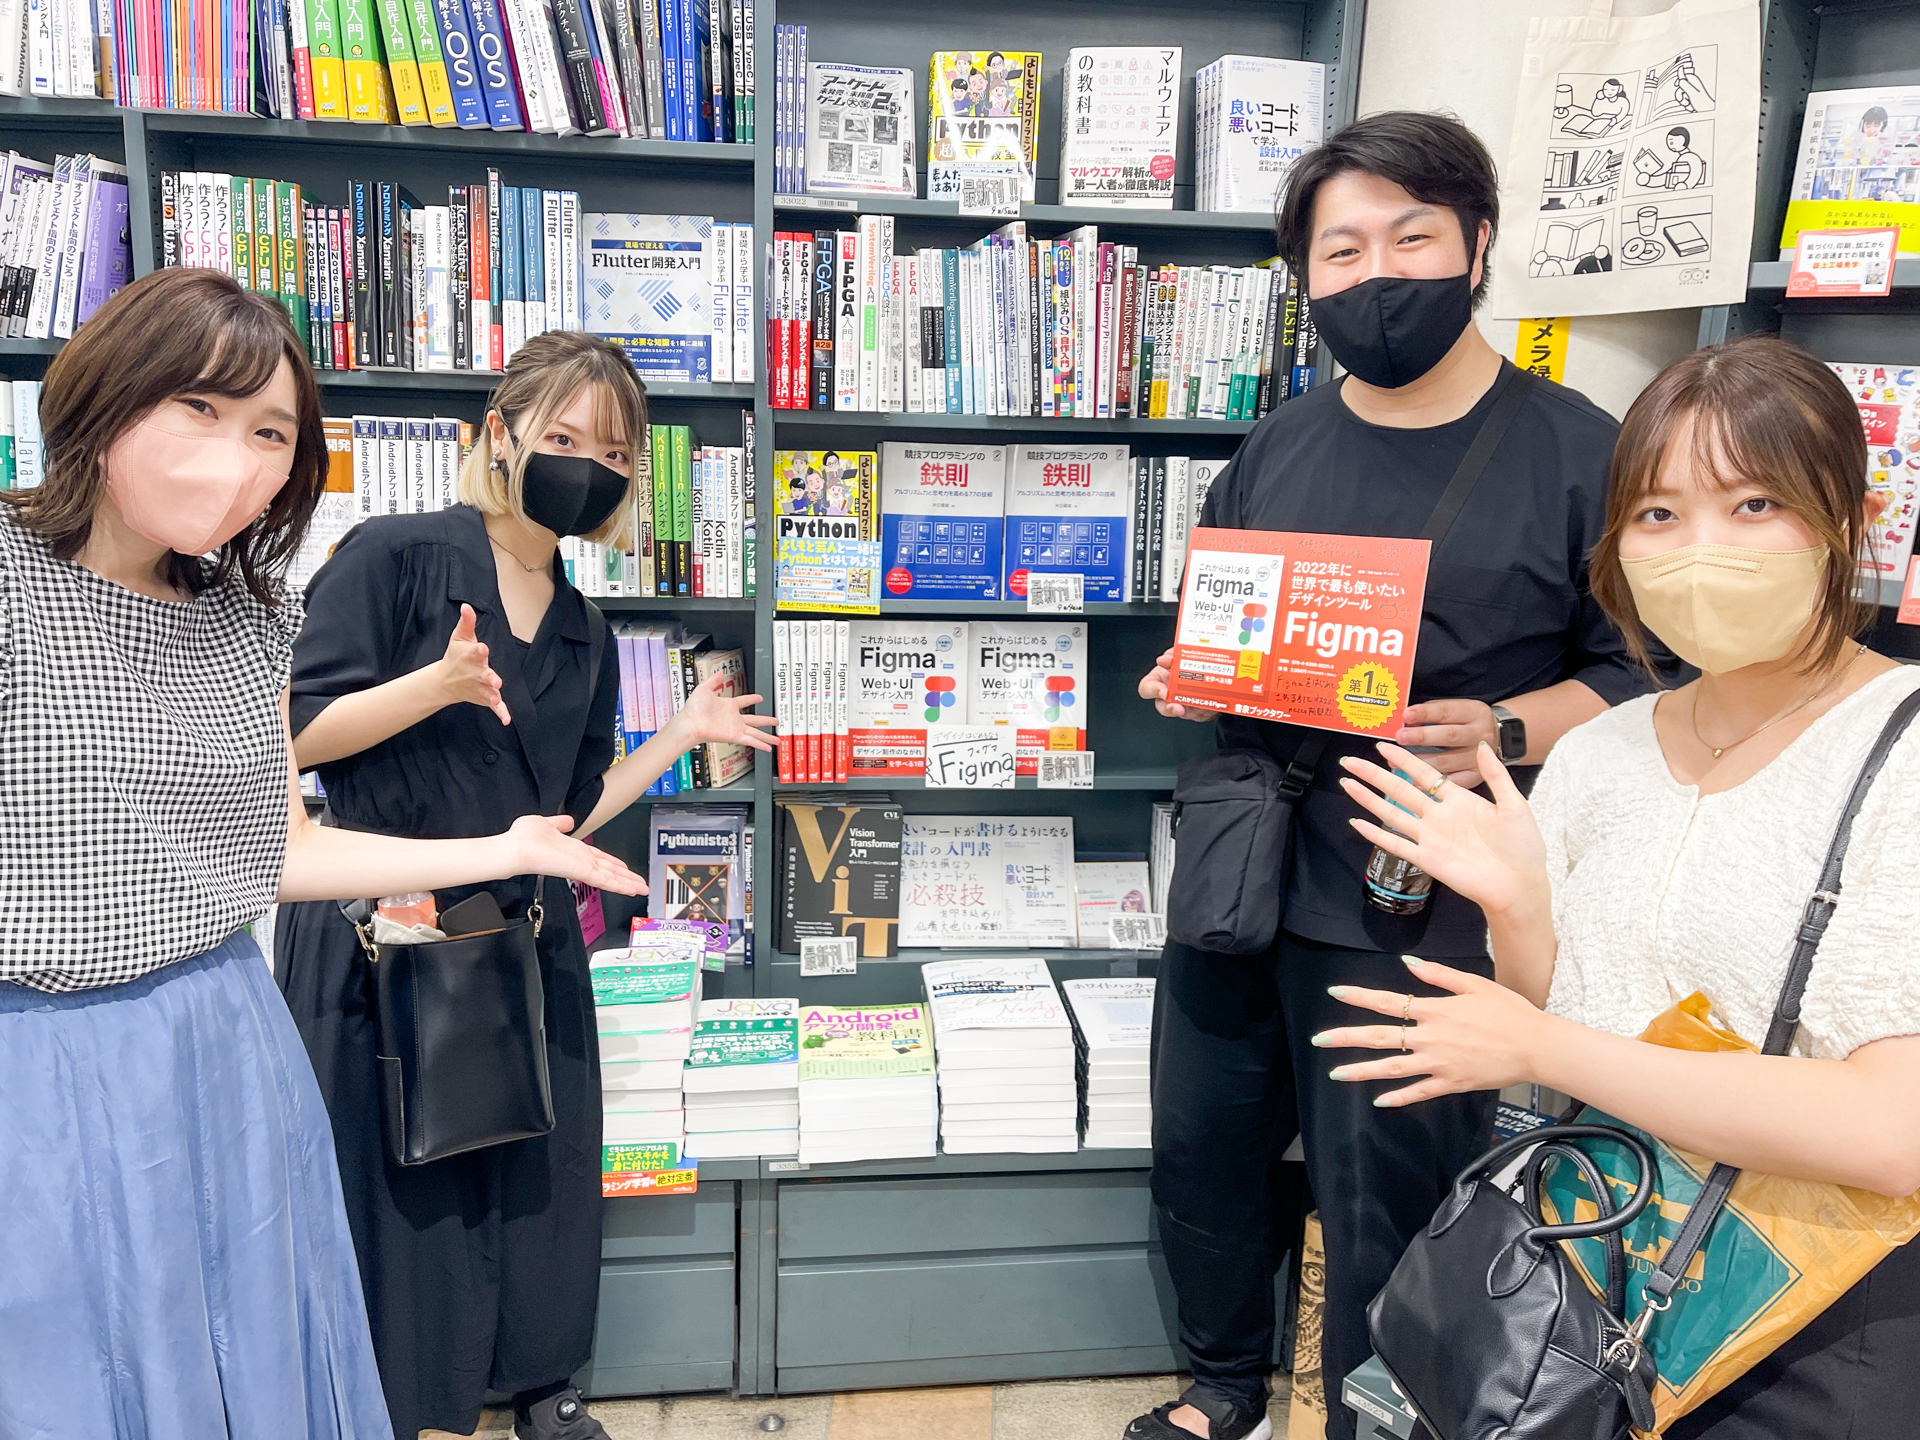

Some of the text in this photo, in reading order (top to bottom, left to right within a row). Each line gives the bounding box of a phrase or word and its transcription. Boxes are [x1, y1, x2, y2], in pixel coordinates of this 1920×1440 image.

[1075, 55, 1093, 134] の教科書
[1156, 51, 1174, 137] マルウエア
[1230, 99, 1299, 119] 良いコード
[1229, 116, 1299, 136] 悪いコード
[1251, 136, 1279, 146] で学ぶ
[1259, 146, 1301, 159] 設計入門
[1069, 166, 1152, 178] マルウエア解析の
[1074, 179, 1171, 191] 第一人者が徹底解説
[547, 199, 558, 238] Flutter
[563, 200, 574, 239] Flutter
[356, 236, 368, 279] Xamarin
[382, 236, 394, 280] Xamarin
[592, 253, 700, 270] Flutter開発入門
[816, 238, 832, 294] FPGA
[713, 285, 729, 333] Flutter
[736, 285, 751, 334] Flutter
[841, 261, 855, 341] FPGA入門
[1102, 286, 1111, 330] Raspberry
[1282, 298, 1298, 346] TLS 1.3
[19, 437, 37, 475] Java
[905, 450, 985, 461] 競技プログラミングの
[1027, 451, 1108, 461] 競技プログラミングの
[920, 462, 969, 487] 鉄則
[1042, 463, 1091, 487] 鉄則
[693, 488, 702, 523] Kotlin
[1136, 467, 1147, 551] ホワイトハッカーの学校
[1153, 468, 1164, 551] ホワイトハッカーの学校
[781, 518, 857, 538] Python
[703, 519, 714, 558] Kotlin
[716, 521, 726, 559] Kotlin
[781, 541, 880, 555] よしもと芸人と一緒に
[781, 553, 880, 568] Pythonをはじめよう!
[1199, 563, 1251, 575] これからはじめる
[1293, 561, 1353, 577] 2022年に
[1196, 573, 1255, 598] Figma
[1291, 576, 1405, 597] 世界で最も使いたい
[1289, 592, 1372, 611] デザインツール
[1193, 612, 1233, 623] デザイン入門
[860, 635, 928, 645] これからはじめる
[980, 636, 1047, 645] これからはじめる
[1283, 610, 1404, 658] Figma
[860, 647, 936, 673] Figma
[980, 647, 1055, 673] Figma
[778, 663, 787, 691] Figma
[794, 663, 803, 691] Figma
[809, 663, 819, 691] Figma
[824, 661, 833, 691] Figma
[838, 663, 847, 692] Figma
[1349, 670, 1389, 696] 第1位
[861, 691, 913, 700] デザイン入門
[982, 690, 1033, 700] デザイン入門
[1234, 703, 1291, 719] 書泉ブックタワー
[857, 748, 922, 756] デザイン制作のながれ
[889, 759, 924, 768] を学べる1冊
[938, 750, 1016, 786] Figma
[659, 833, 737, 849] Pythonista3
[849, 828, 875, 838] Vision
[849, 838, 900, 848] Transformer
[721, 846, 737, 855] 入門
[849, 849, 867, 858] 入門
[1006, 864, 1050, 874] 良いコード
[1005, 875, 1050, 884] 悪いコード
[905, 883, 985, 907] 必殺技
[616, 948, 693, 960] Java
[717, 1000, 792, 1012] Java
[804, 1008, 919, 1023] Android
[859, 1029, 922, 1041] 教科書
[607, 1151, 669, 1161] これでスキルを
[612, 1160, 664, 1171] 身に付けた!
[657, 1172, 693, 1185] 絶対定番
